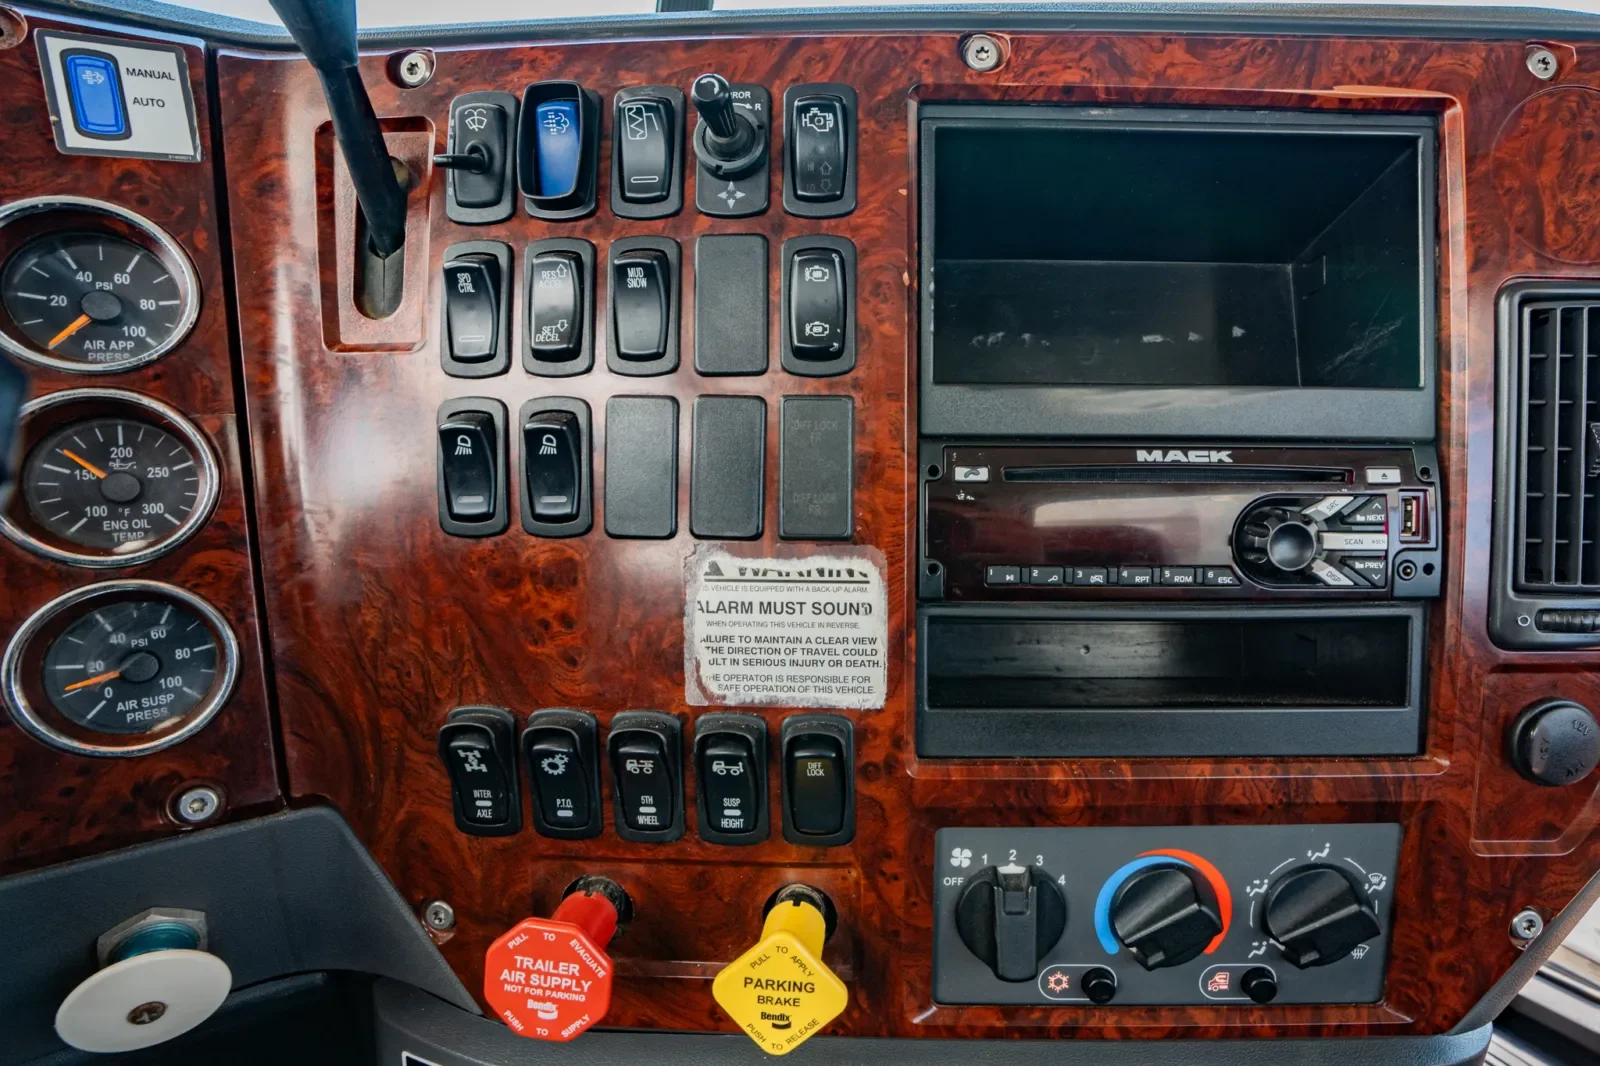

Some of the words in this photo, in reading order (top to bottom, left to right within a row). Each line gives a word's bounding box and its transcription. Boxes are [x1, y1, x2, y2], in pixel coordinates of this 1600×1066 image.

[126, 67, 176, 81] MANUAL
[132, 97, 165, 108] AUTO
[75, 271, 93, 282] 40
[457, 273, 471, 283] SPD
[627, 268, 644, 277] MUD
[114, 273, 130, 284] 60
[627, 277, 647, 289] SNOW
[95, 282, 113, 290] PSI
[458, 283, 475, 293] CTRL
[50, 295, 67, 306] 20
[140, 299, 156, 310] 80
[122, 326, 146, 337] 100
[541, 325, 557, 335] SET
[536, 333, 560, 342] DECEL
[83, 340, 105, 350] AIR
[109, 340, 135, 350] APP
[88, 352, 131, 361] PRESS
[110, 448, 133, 458] 200
[1136, 450, 1233, 463] MACK
[74, 469, 97, 480] 150
[147, 467, 169, 478] 250
[84, 506, 108, 517] 100
[142, 503, 164, 514] 300
[103, 520, 129, 531] ENG
[131, 519, 151, 529] OIL
[112, 531, 144, 542] TEMP
[1326, 571, 1342, 583] DISP
[759, 601, 806, 615] MUST
[811, 602, 872, 616] SOUND
[109, 633, 126, 644] 40
[150, 629, 166, 640] 60
[131, 638, 148, 648] PSI
[754, 636, 802, 644] MAINTAIN
[815, 637, 849, 645] CLEAR
[852, 637, 878, 645] VIEW
[175, 648, 191, 659] 80
[727, 647, 781, 655] DIRECTION
[783, 647, 798, 655] OF
[800, 648, 840, 656] TRAVEL
[842, 648, 878, 656] COULD
[87, 661, 104, 672] 20
[730, 658, 739, 666] IN
[742, 658, 786, 667] SERIOUS
[789, 659, 825, 667] INJURY
[159, 676, 183, 689] 100
[723, 674, 773, 682] OPERATOR
[775, 674, 784, 682] IS
[786, 675, 849, 683] RESPONSIBLE
[104, 688, 113, 699] 0
[718, 684, 740, 692] SAFE
[743, 684, 795, 693] OPERATION
[798, 685, 811, 693] OF
[813, 685, 833, 693] THIS
[835, 686, 876, 694] VEHICLE.
[116, 701, 138, 712] AIR
[141, 694, 175, 707] SUSP
[126, 708, 168, 723] PRESS
[806, 769, 824, 777] LOCK
[473, 790, 492, 798] INTER
[557, 799, 573, 808] P.T.O.
[641, 796, 653, 805] 5TH
[723, 798, 741, 807] SUSP
[476, 809, 492, 818] AXLE
[638, 815, 659, 825] WHEEL
[721, 818, 744, 829] HEIGHT
[981, 854, 988, 864] 1
[1009, 849, 1017, 861] 2
[1036, 855, 1044, 866] 3
[943, 877, 964, 886] OFF
[1058, 874, 1066, 885] 4
[508, 933, 529, 949] PULL
[543, 932, 556, 941] TO
[569, 939, 606, 979] EVACUATE
[514, 956, 579, 976] TRAILER
[750, 954, 770, 969] PULL
[776, 946, 788, 954] TO
[789, 955, 815, 978] APPLY
[500, 969, 525, 983] AIR
[530, 973, 592, 993] SUPPLY
[744, 977, 815, 993] PARKING
[504, 984, 523, 993] NOT
[525, 987, 543, 997] FOR
[545, 988, 586, 1002] PARKING
[757, 995, 800, 1007] BRAKE
[761, 1012, 790, 1022] Bendix
[504, 1010, 524, 1032] PUSH
[536, 1027, 549, 1036] TO
[561, 1014, 591, 1038] SUPPLY
[746, 1023, 767, 1043] PUSH
[785, 1018, 820, 1045] RELEASE
